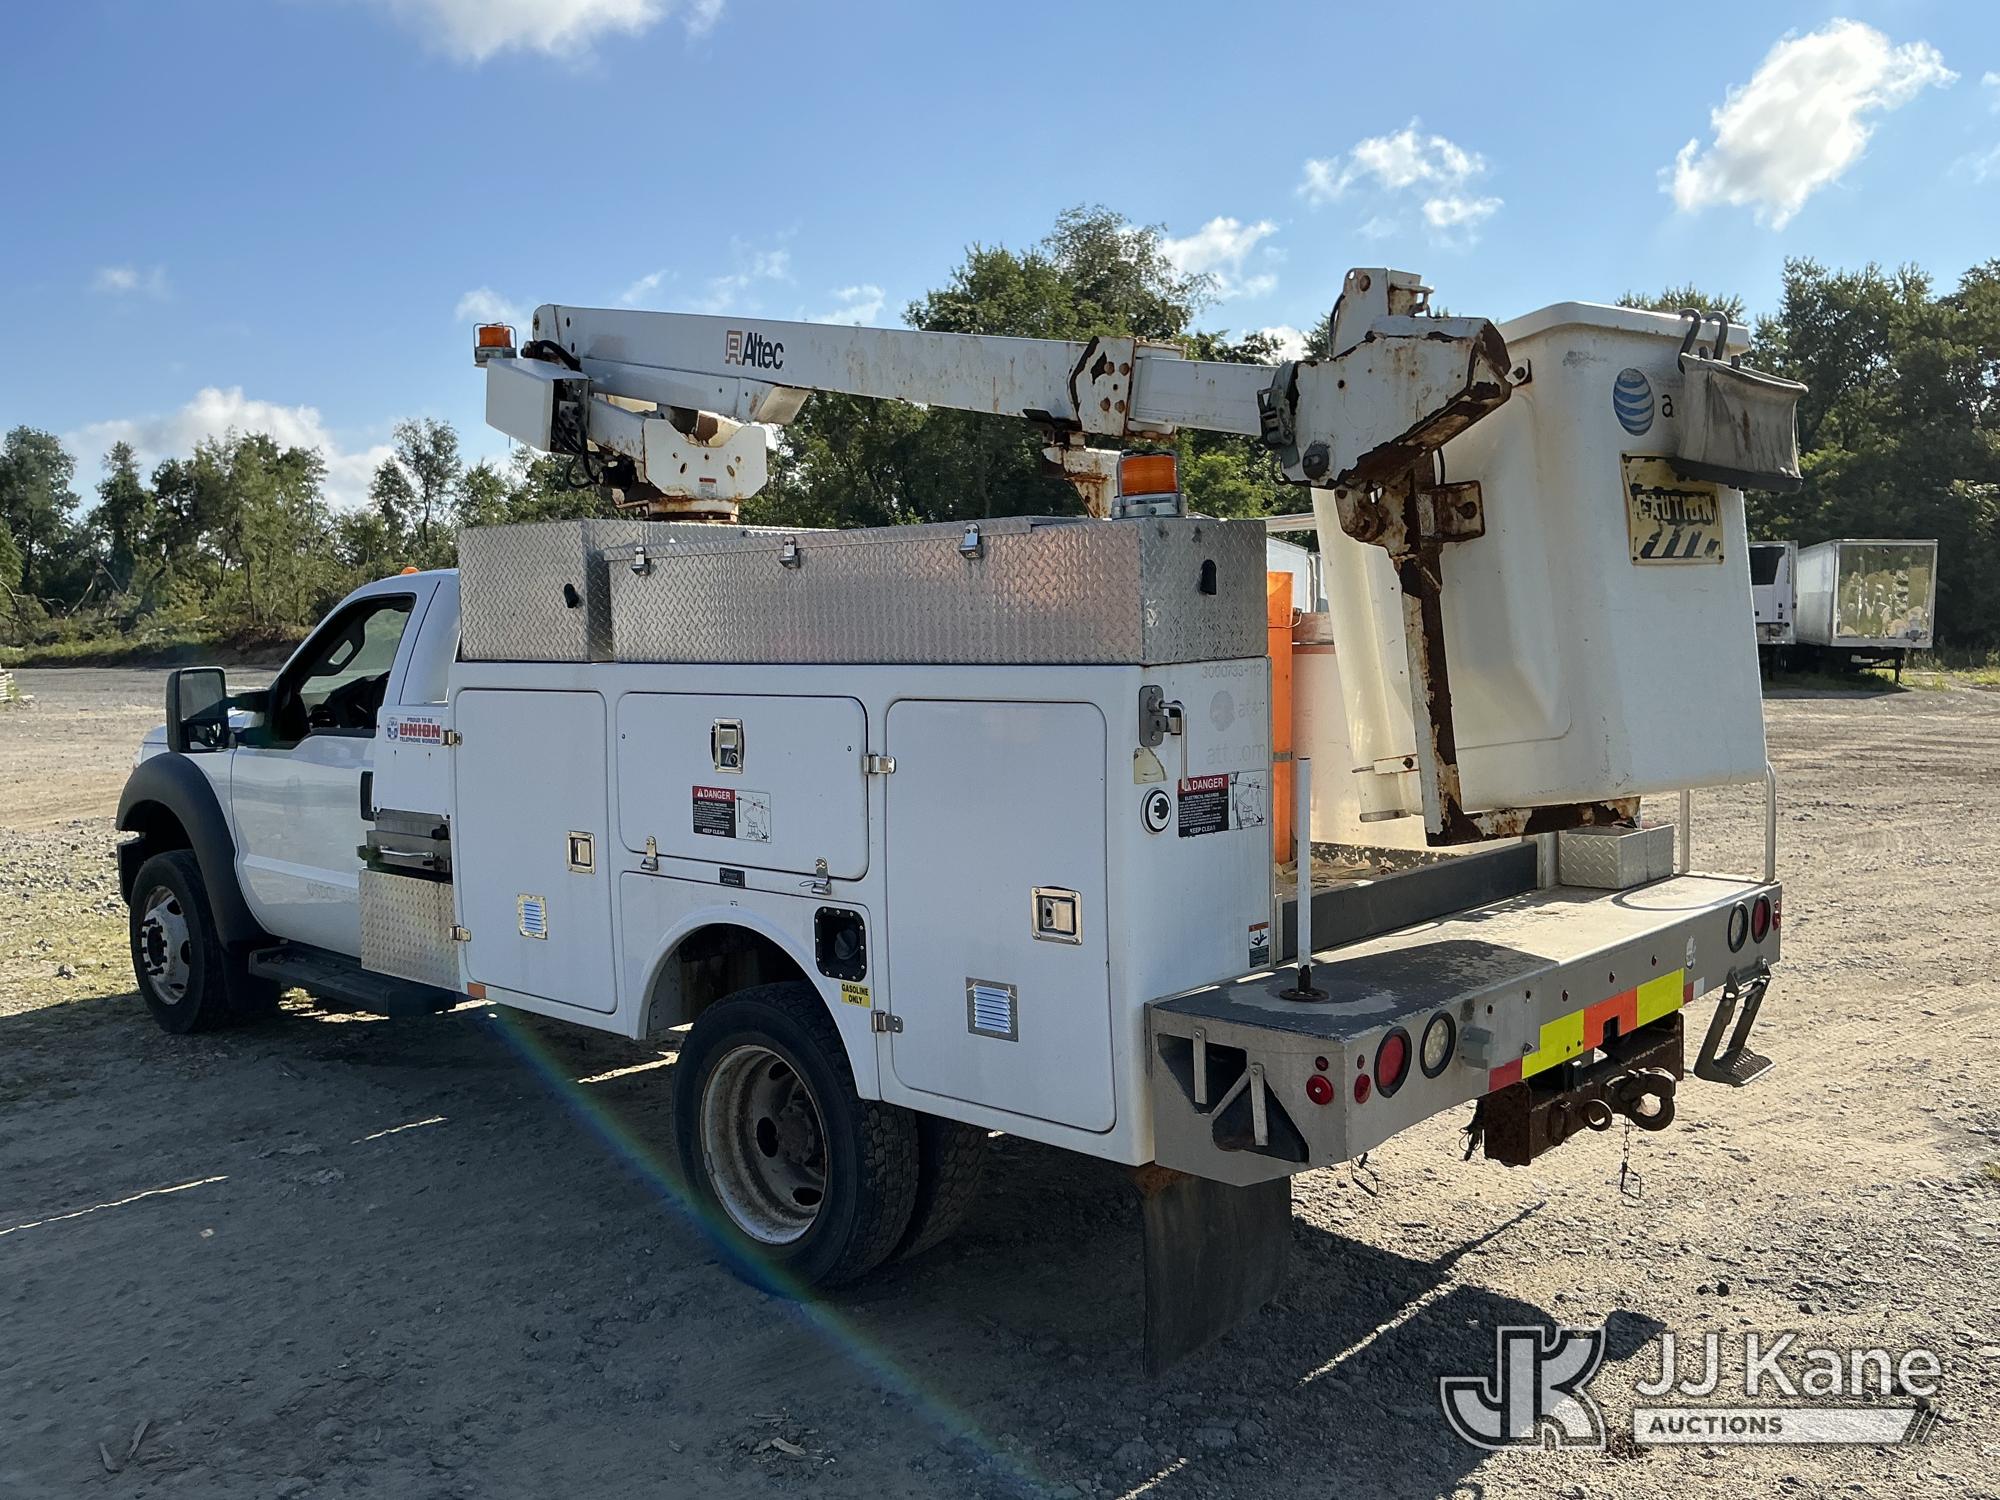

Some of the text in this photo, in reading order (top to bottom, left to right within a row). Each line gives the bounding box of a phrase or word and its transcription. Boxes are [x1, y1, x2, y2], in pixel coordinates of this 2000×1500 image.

[741, 332, 784, 370] Altec
[1635, 494, 1714, 521] CAUTION
[400, 723, 441, 738] UNION
[1207, 743, 1266, 765] att.om
[1192, 777, 1223, 791] DANGER
[703, 789, 731, 800] DANGER
[841, 983, 869, 996] GASOLINE
[848, 994, 863, 1004] ONLY
